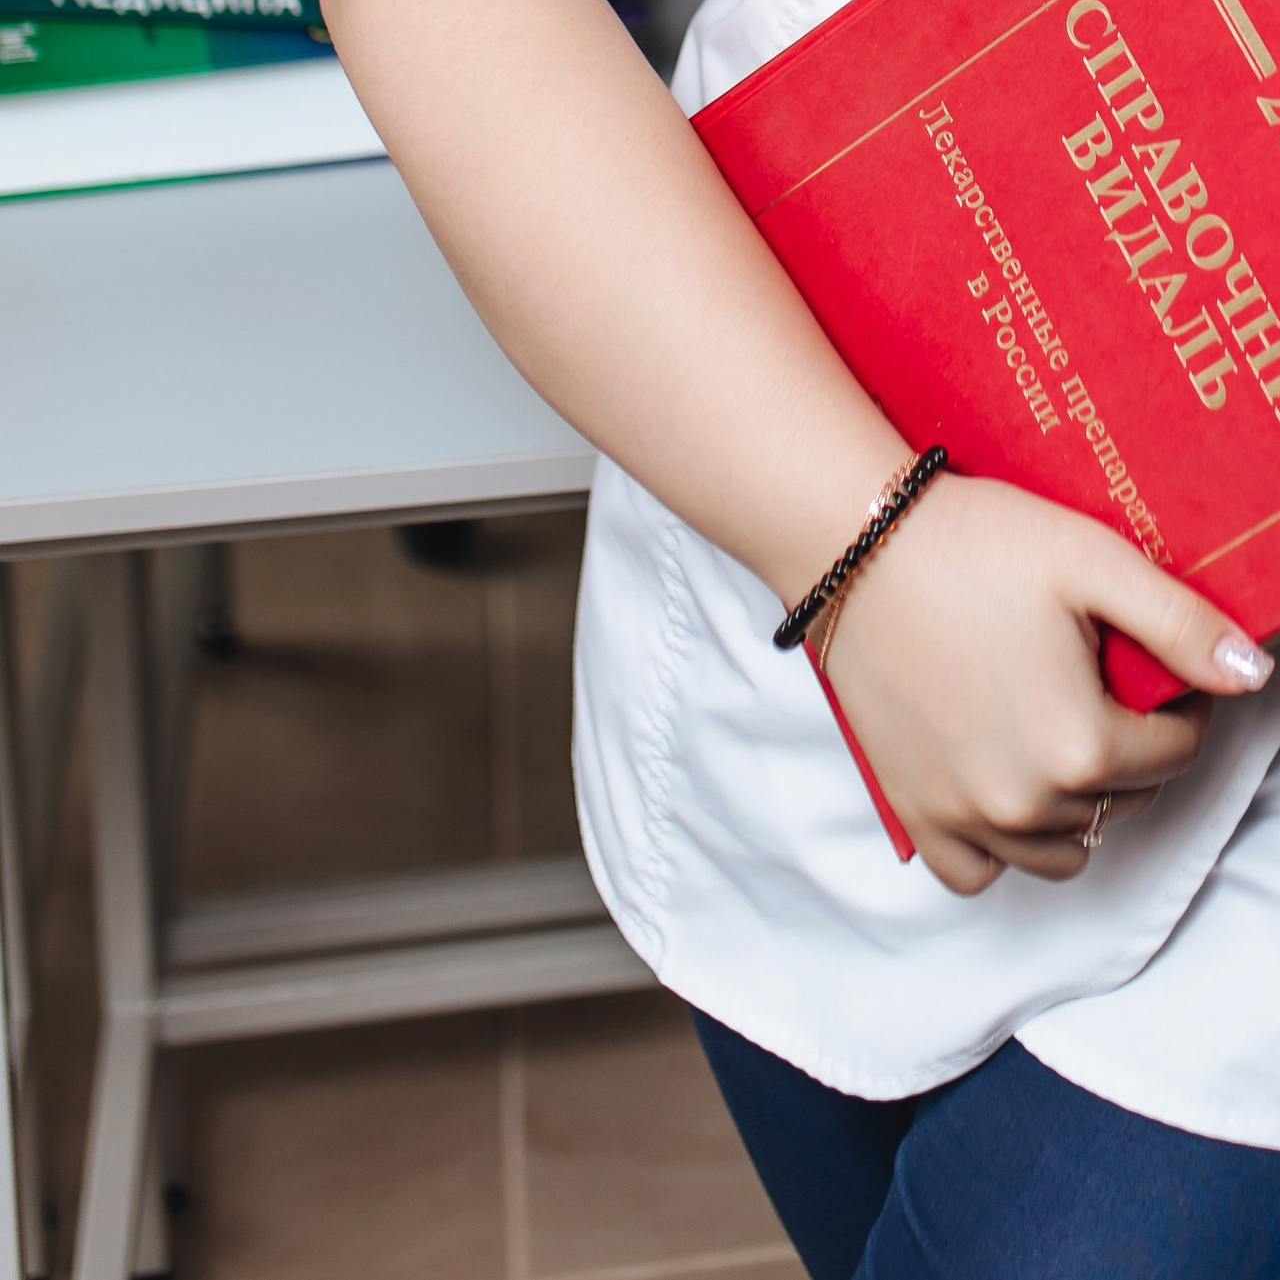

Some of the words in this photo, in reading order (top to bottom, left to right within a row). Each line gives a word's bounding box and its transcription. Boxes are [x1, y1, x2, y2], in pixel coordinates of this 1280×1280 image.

[918, 100, 1069, 372] Лекарственные
[966, 269, 990, 300] в
[981, 293, 1062, 436] России
[1061, 110, 1239, 411] ВИДАЛЬ
